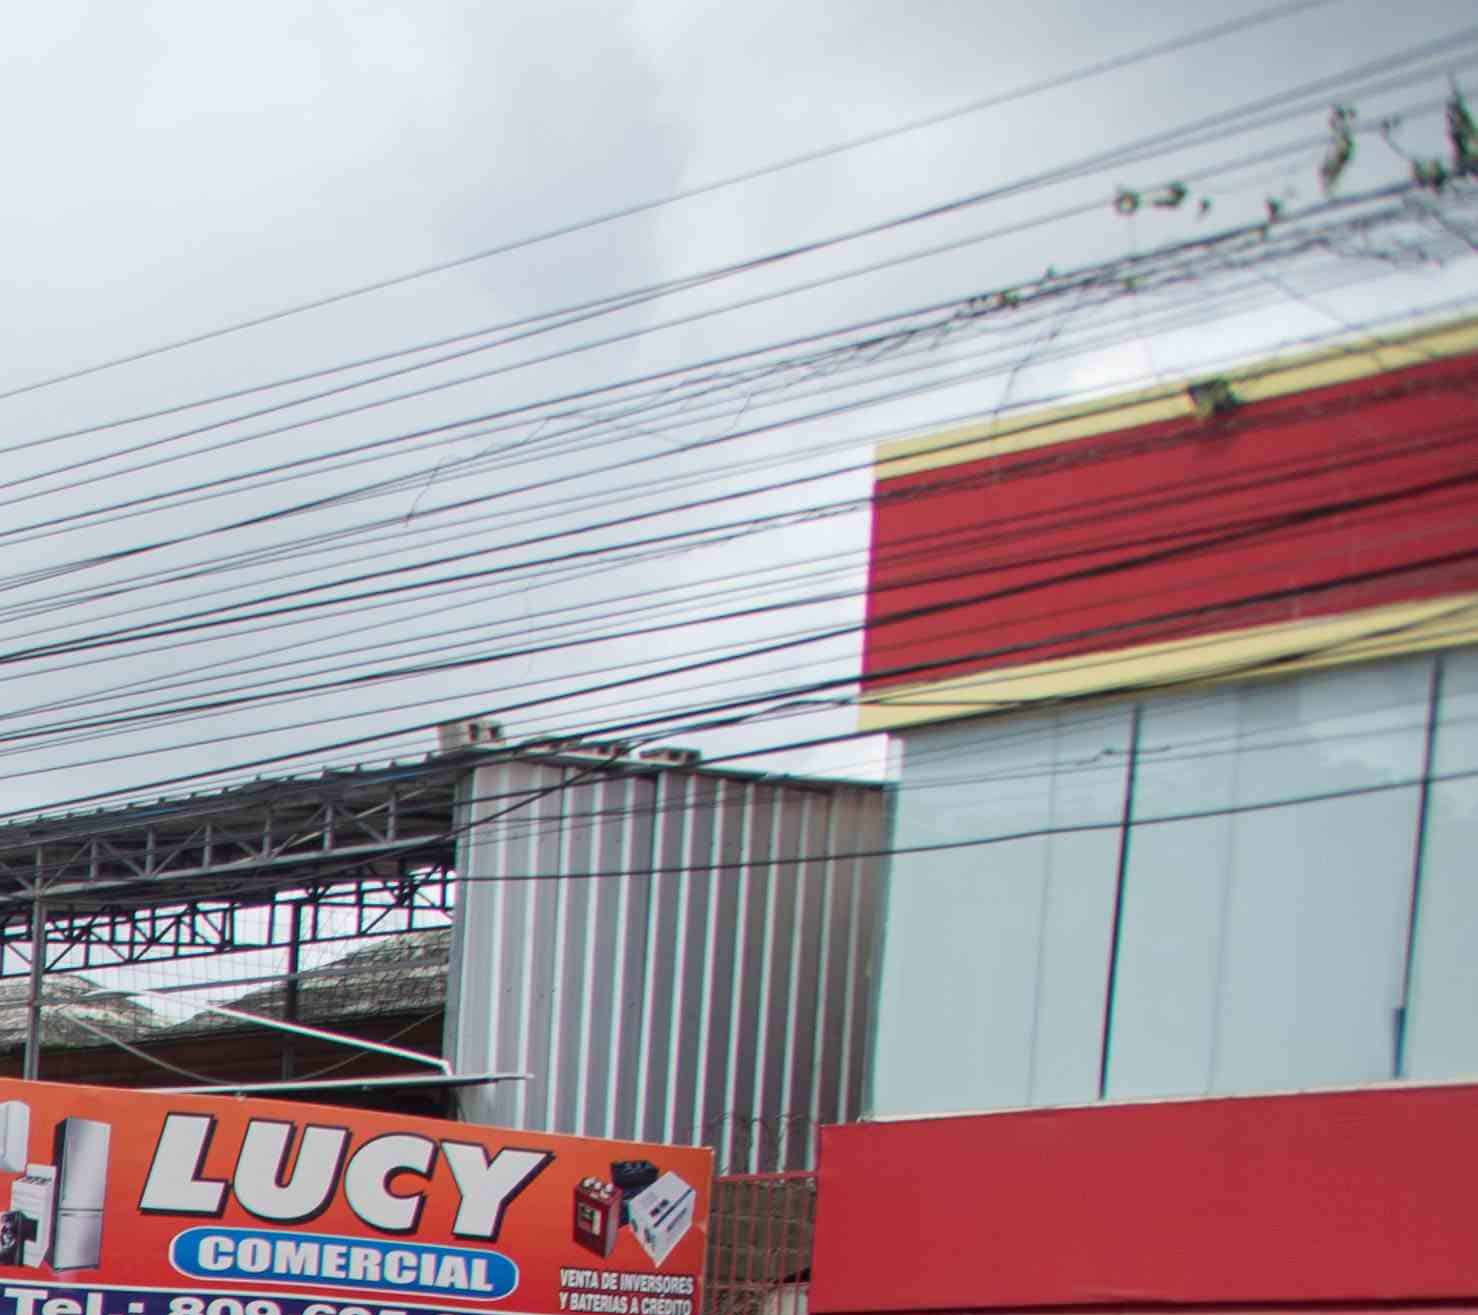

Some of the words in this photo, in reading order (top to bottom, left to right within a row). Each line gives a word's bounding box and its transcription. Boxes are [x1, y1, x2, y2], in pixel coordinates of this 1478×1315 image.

[138, 1113, 553, 1241] LUCY
[198, 1235, 495, 1292] COMERCIAL
[560, 1268, 599, 1289] VENTA
[601, 1271, 619, 1291] DE
[620, 1273, 694, 1295] INVERSORES
[559, 1291, 569, 1310] Y
[629, 1297, 640, 1315] A
